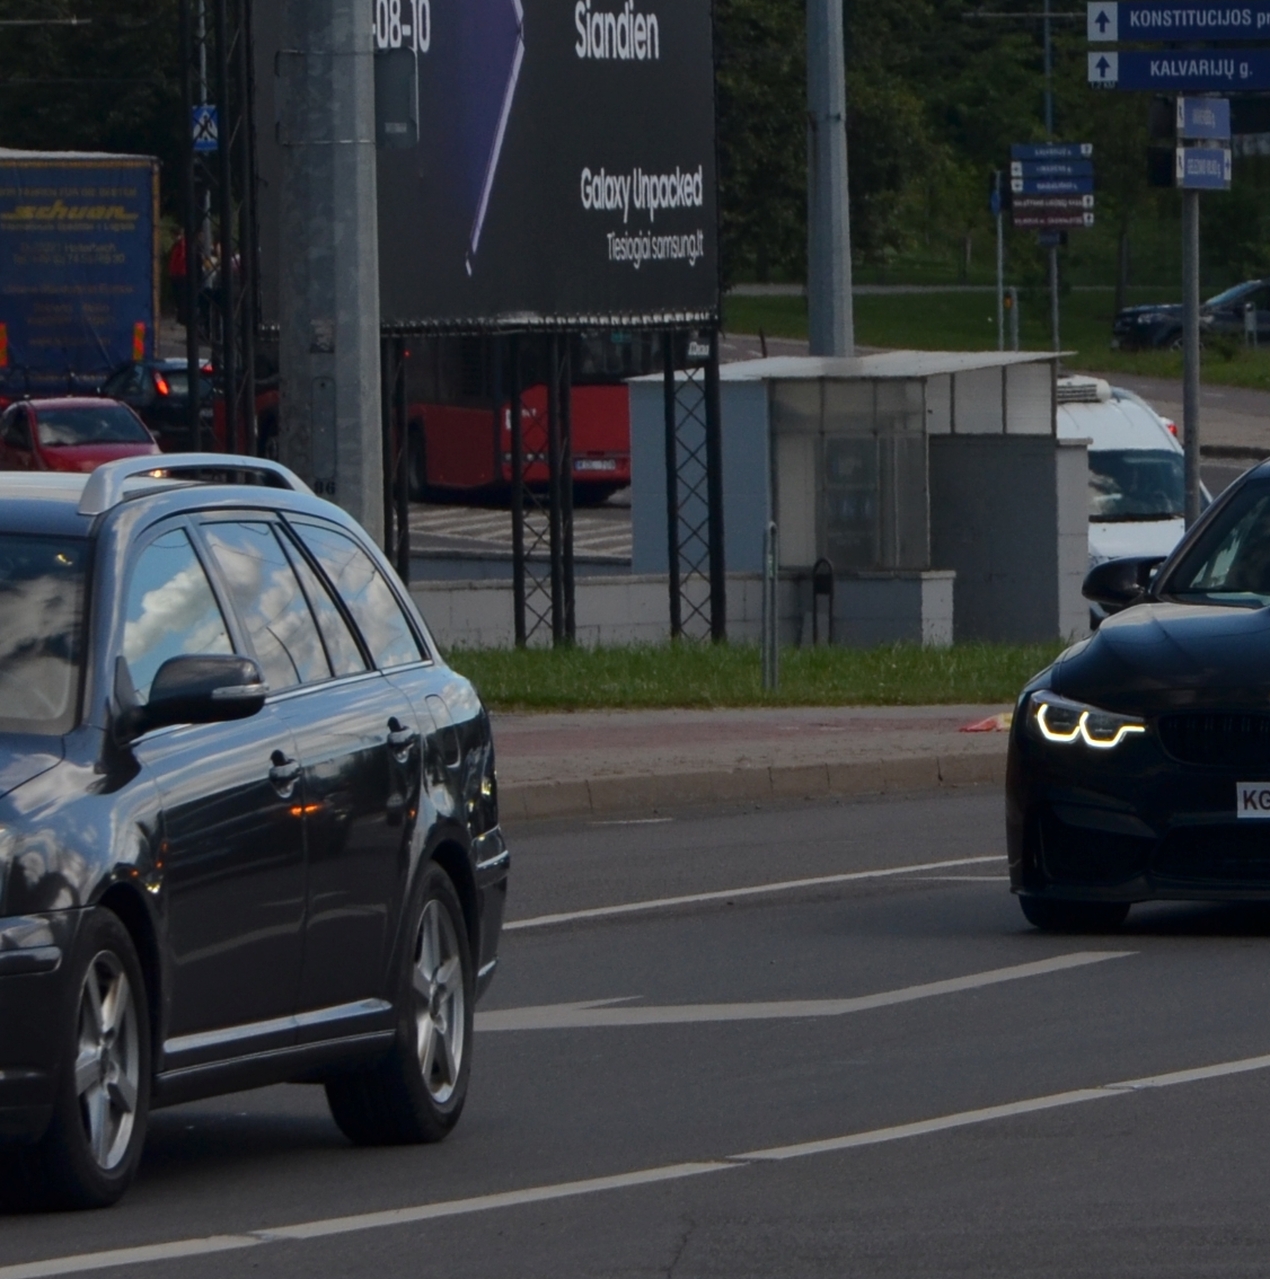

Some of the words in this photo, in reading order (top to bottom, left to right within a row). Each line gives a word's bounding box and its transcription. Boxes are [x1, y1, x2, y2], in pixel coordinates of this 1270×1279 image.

[1129, 9, 1252, 28] KONSTITUCIJOS
[1150, 59, 1235, 80] KALVARIJŲ
[1239, 60, 1253, 79] g.
[580, 167, 632, 224] Galaxy
[633, 164, 703, 223] Unpacked
[606, 230, 651, 269] Tiesiogiai
[652, 228, 704, 267] samsung.lt
